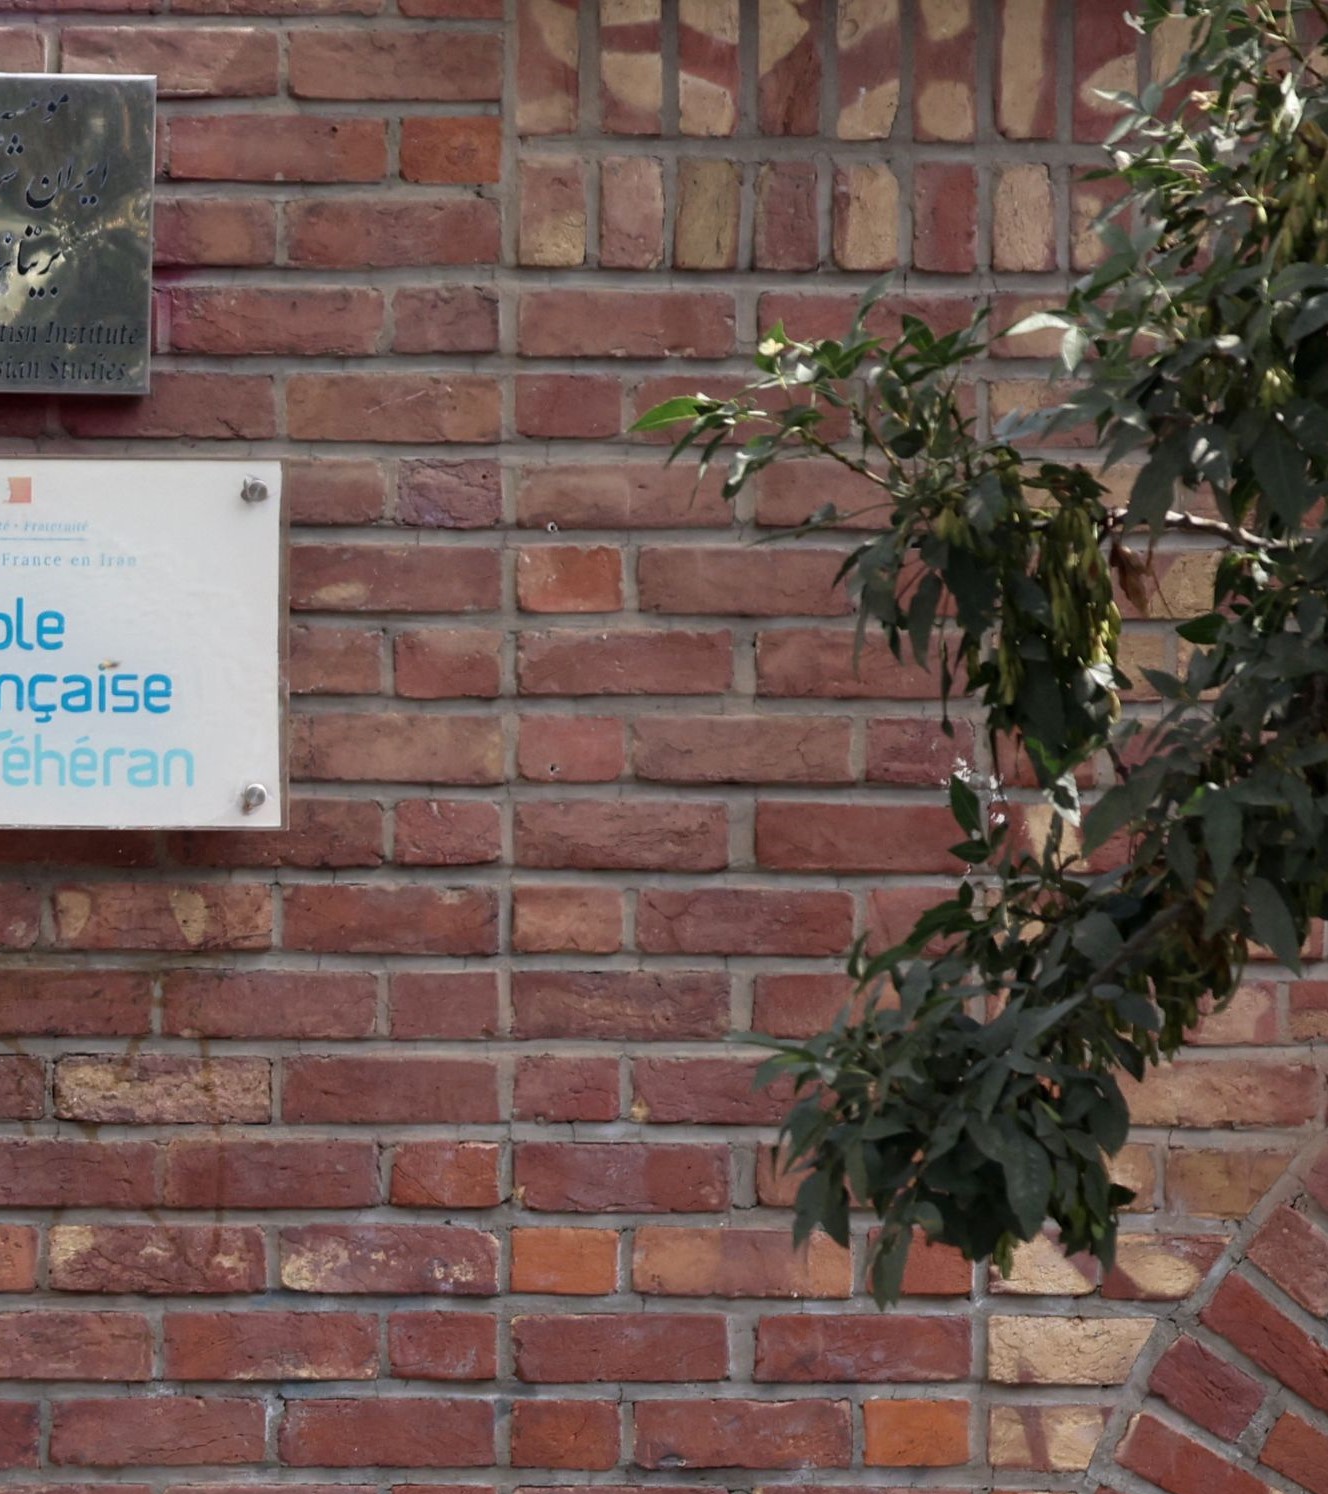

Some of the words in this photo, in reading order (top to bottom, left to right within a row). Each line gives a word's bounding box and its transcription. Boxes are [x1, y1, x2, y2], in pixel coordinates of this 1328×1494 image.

[44, 320, 139, 346] Institute
[48, 353, 127, 382] Studies
[2, 552, 62, 567] France
[70, 555, 91, 567] en
[100, 553, 138, 568] Iran
